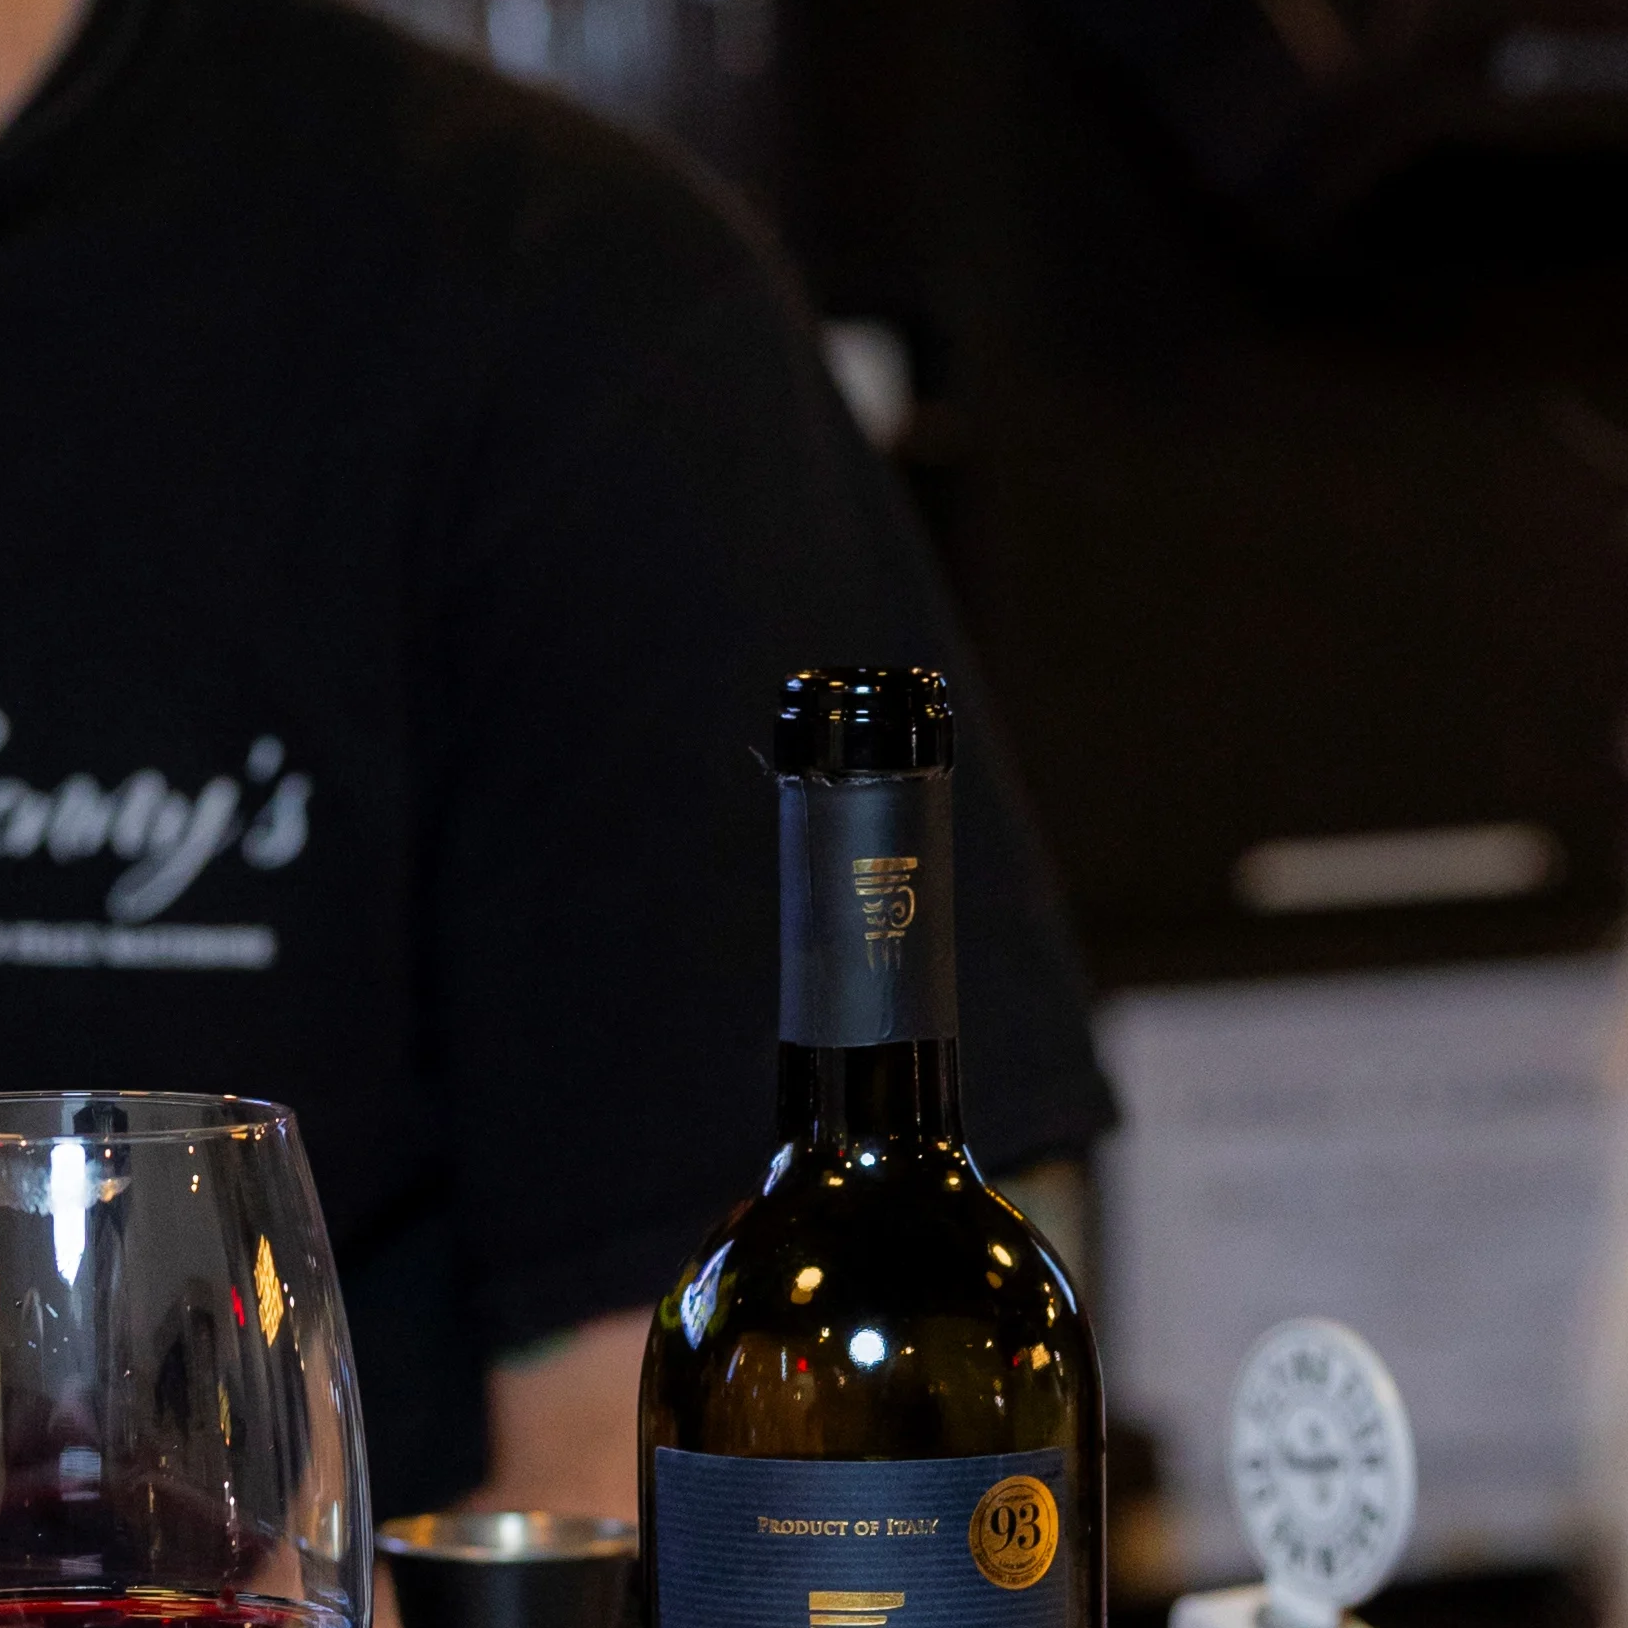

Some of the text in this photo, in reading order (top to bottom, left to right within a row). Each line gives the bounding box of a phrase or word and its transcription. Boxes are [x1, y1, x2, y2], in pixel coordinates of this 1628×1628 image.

[757, 1515, 940, 1537] PRODUCT OF ITALY
[990, 1502, 1041, 1554] 93
